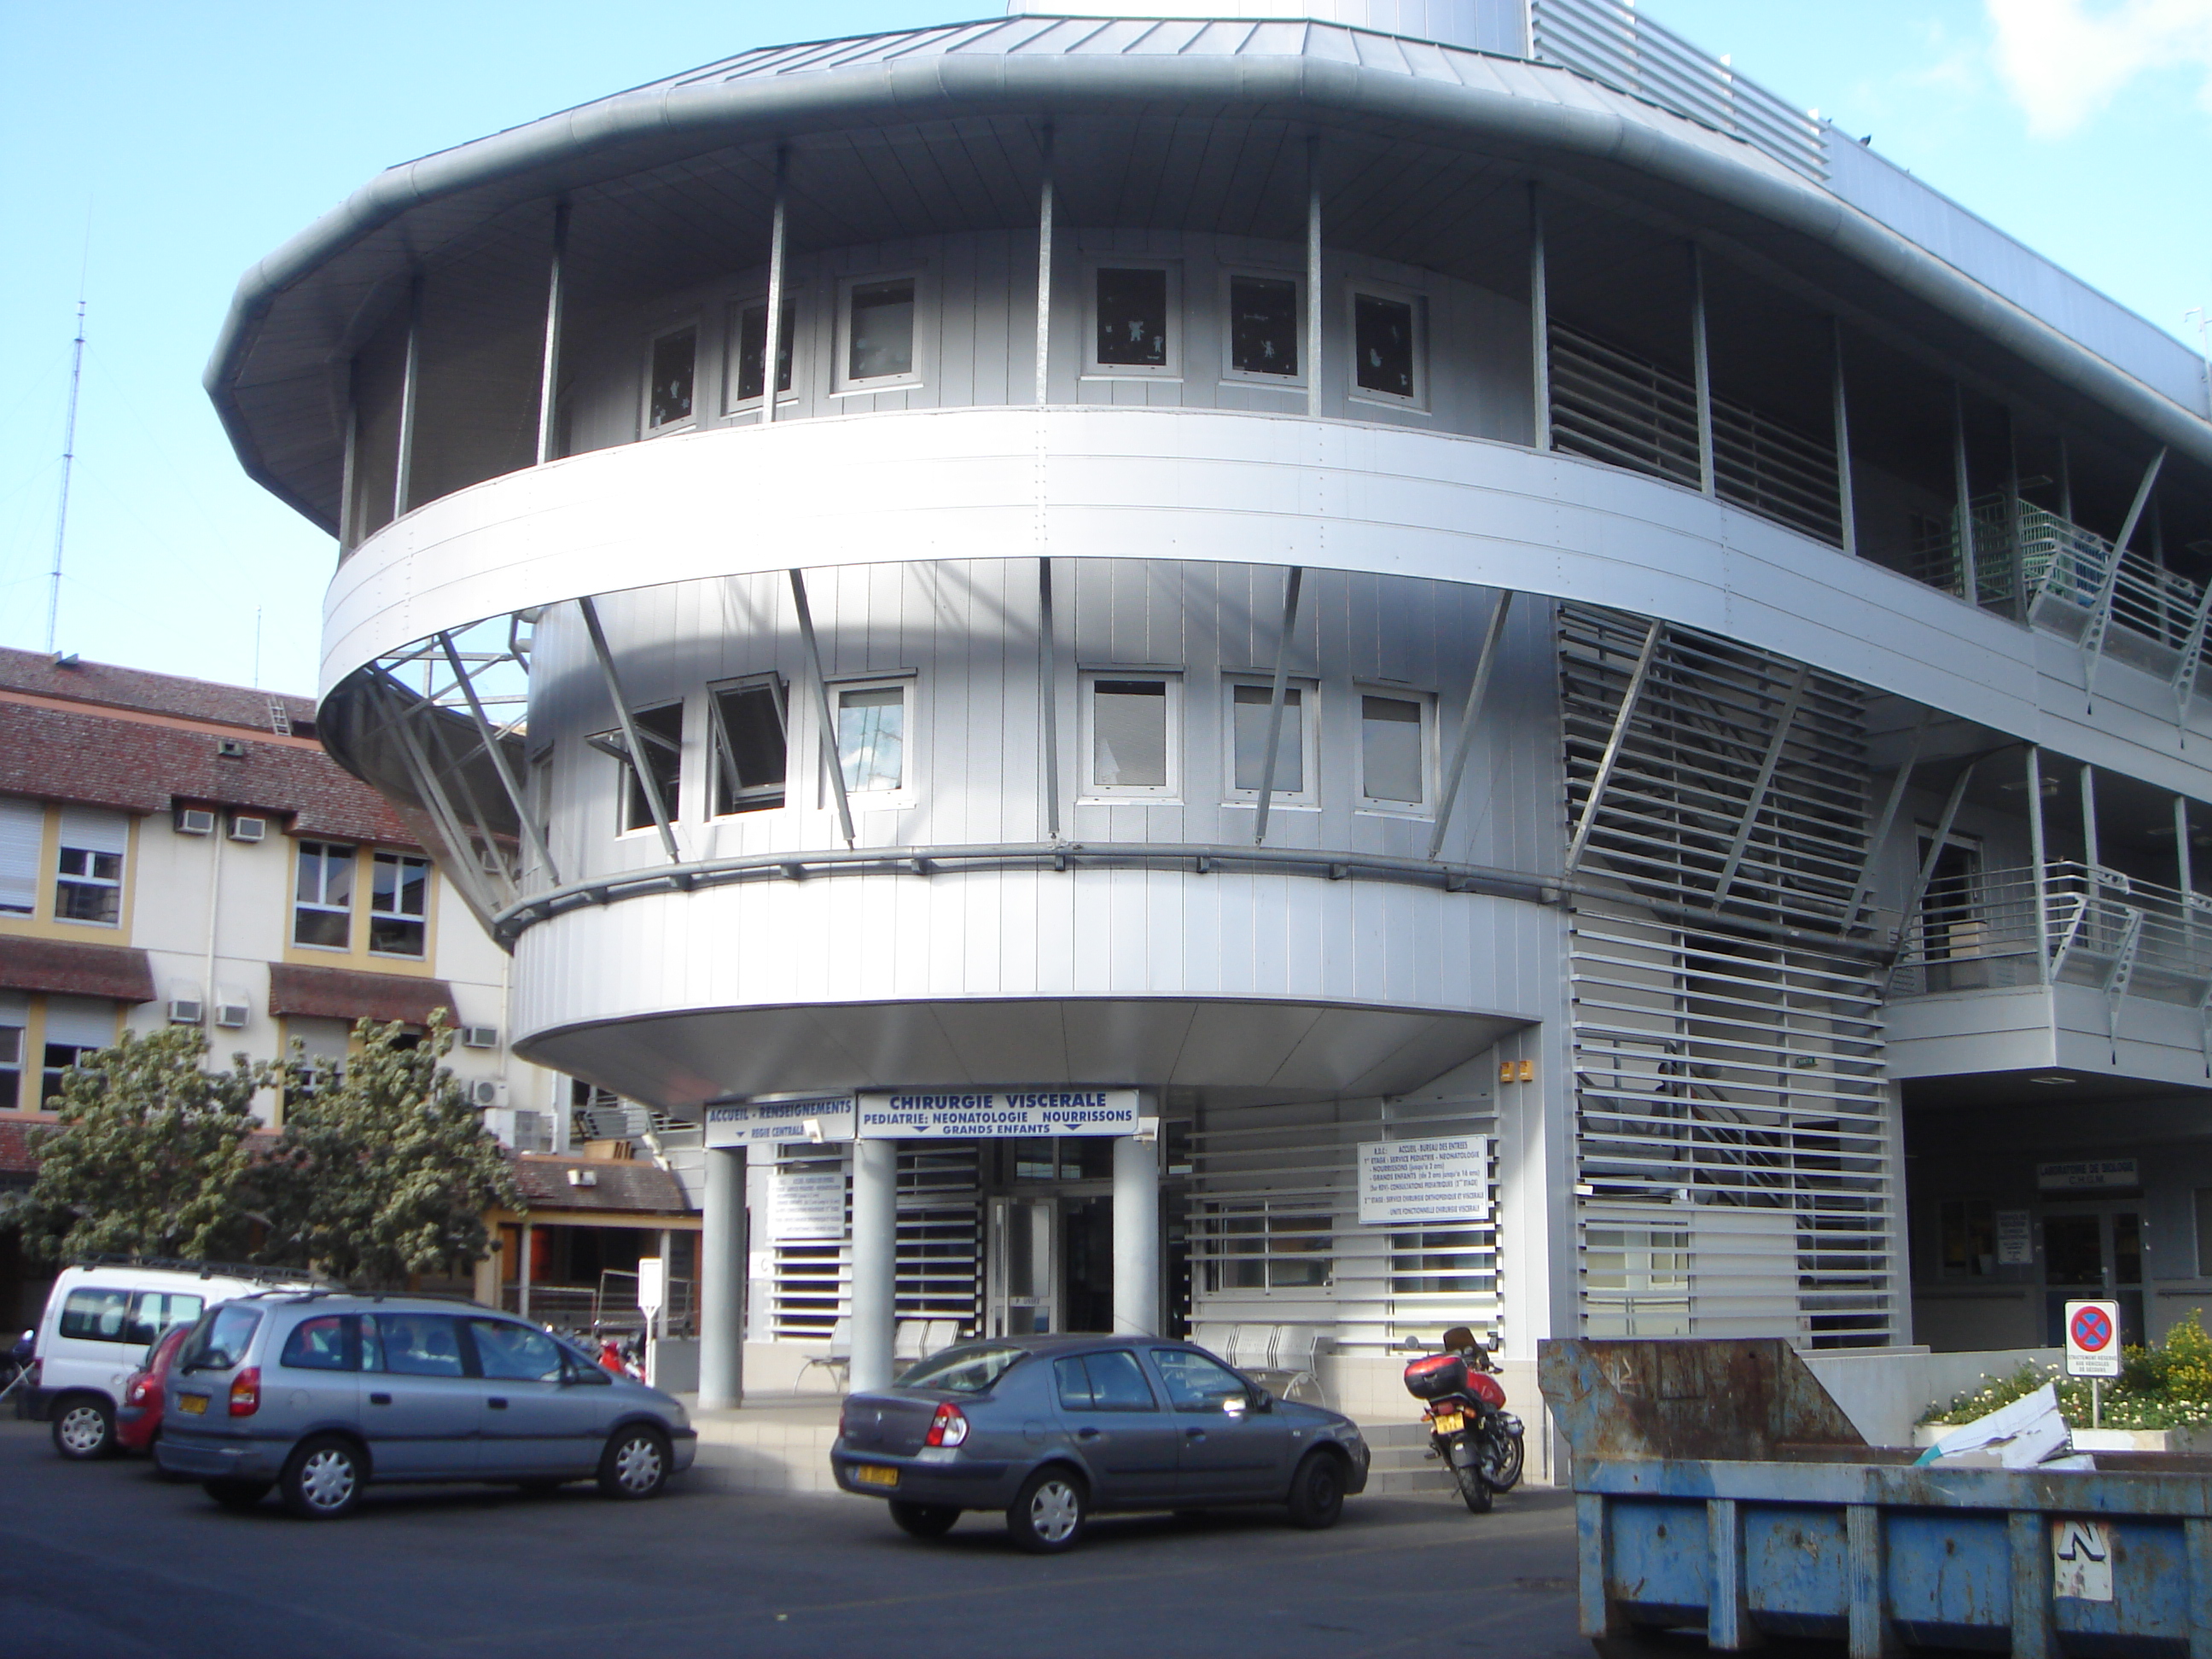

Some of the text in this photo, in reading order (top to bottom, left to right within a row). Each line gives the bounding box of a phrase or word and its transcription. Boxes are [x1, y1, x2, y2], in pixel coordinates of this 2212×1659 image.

[890, 1092, 1107, 1110] CHIRURGIE VISCERALE
[709, 1108, 748, 1122] ACCUEIL
[759, 1100, 851, 1119] RENSEIGNEMENTS
[864, 1110, 1132, 1125] PEDIATRIE: NEONATOLOGIE NOURRISSONS
[751, 1126, 771, 1138] REGIE
[943, 1124, 1051, 1134] GRANDS ENFANTS
[1420, 1144, 1438, 1152] BUREAU
[1448, 1141, 1468, 1150] ENTREES
[1439, 1150, 1479, 1160] NEONATOLOGIE
[2040, 1161, 2133, 1176] LABORATOIRE DE BIOLOGIE
[1390, 1182, 1423, 1190] CONSULTATIONS
